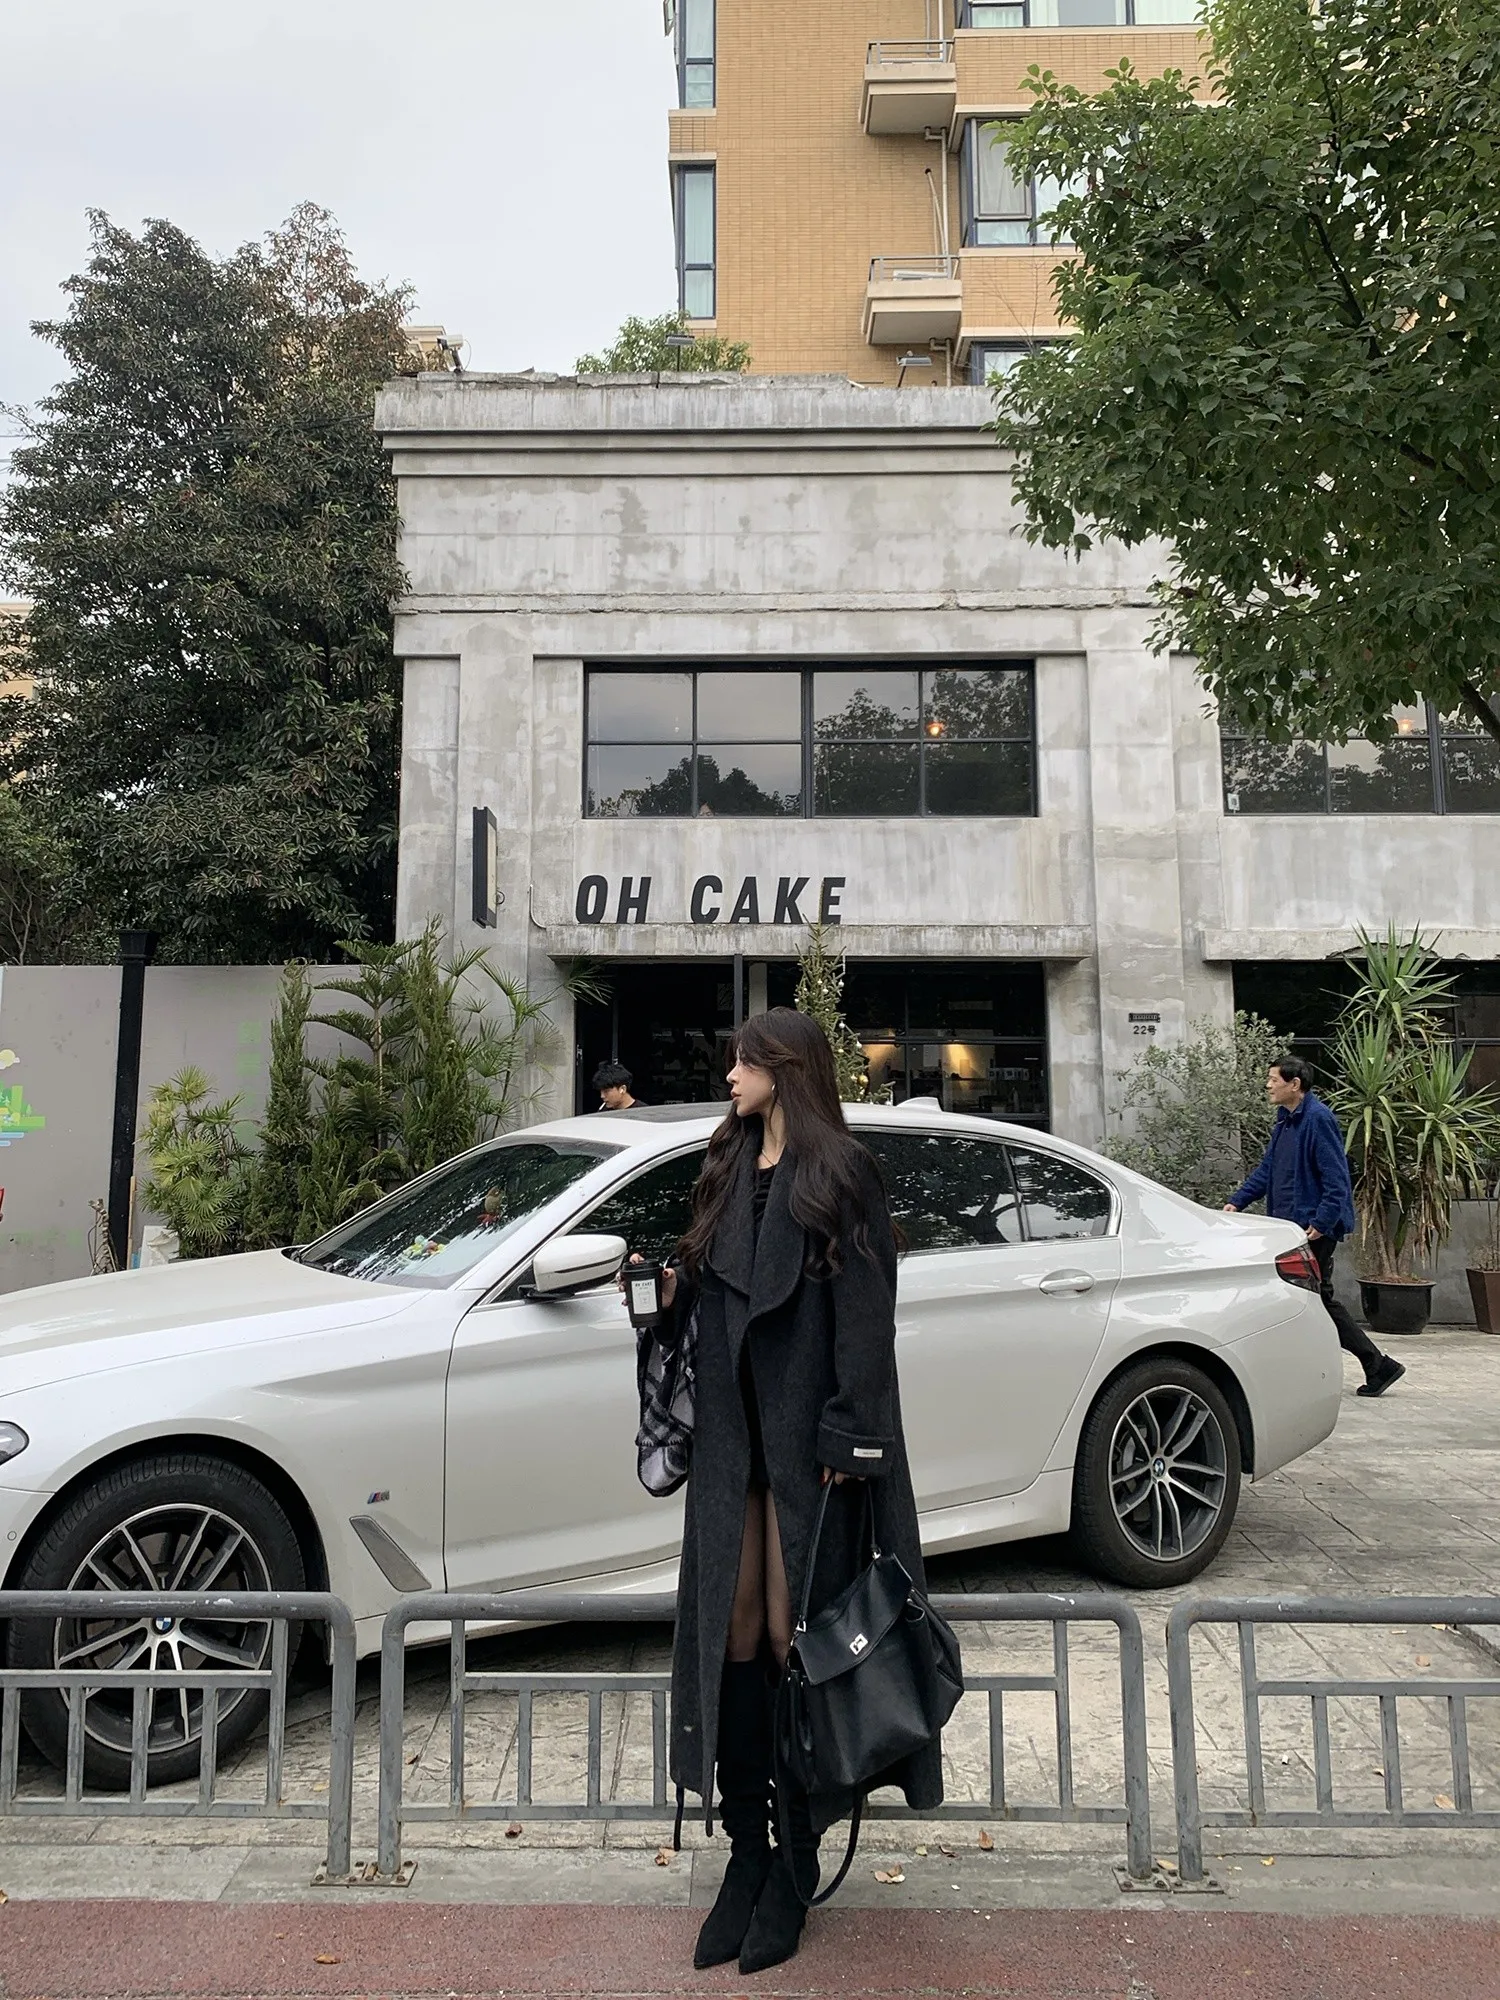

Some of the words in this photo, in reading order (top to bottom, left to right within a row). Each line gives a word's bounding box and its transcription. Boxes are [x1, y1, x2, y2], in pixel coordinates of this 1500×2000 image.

[575, 874, 652, 924] OH
[690, 874, 846, 924] CAKE
[1133, 1025, 1157, 1036] 22号
